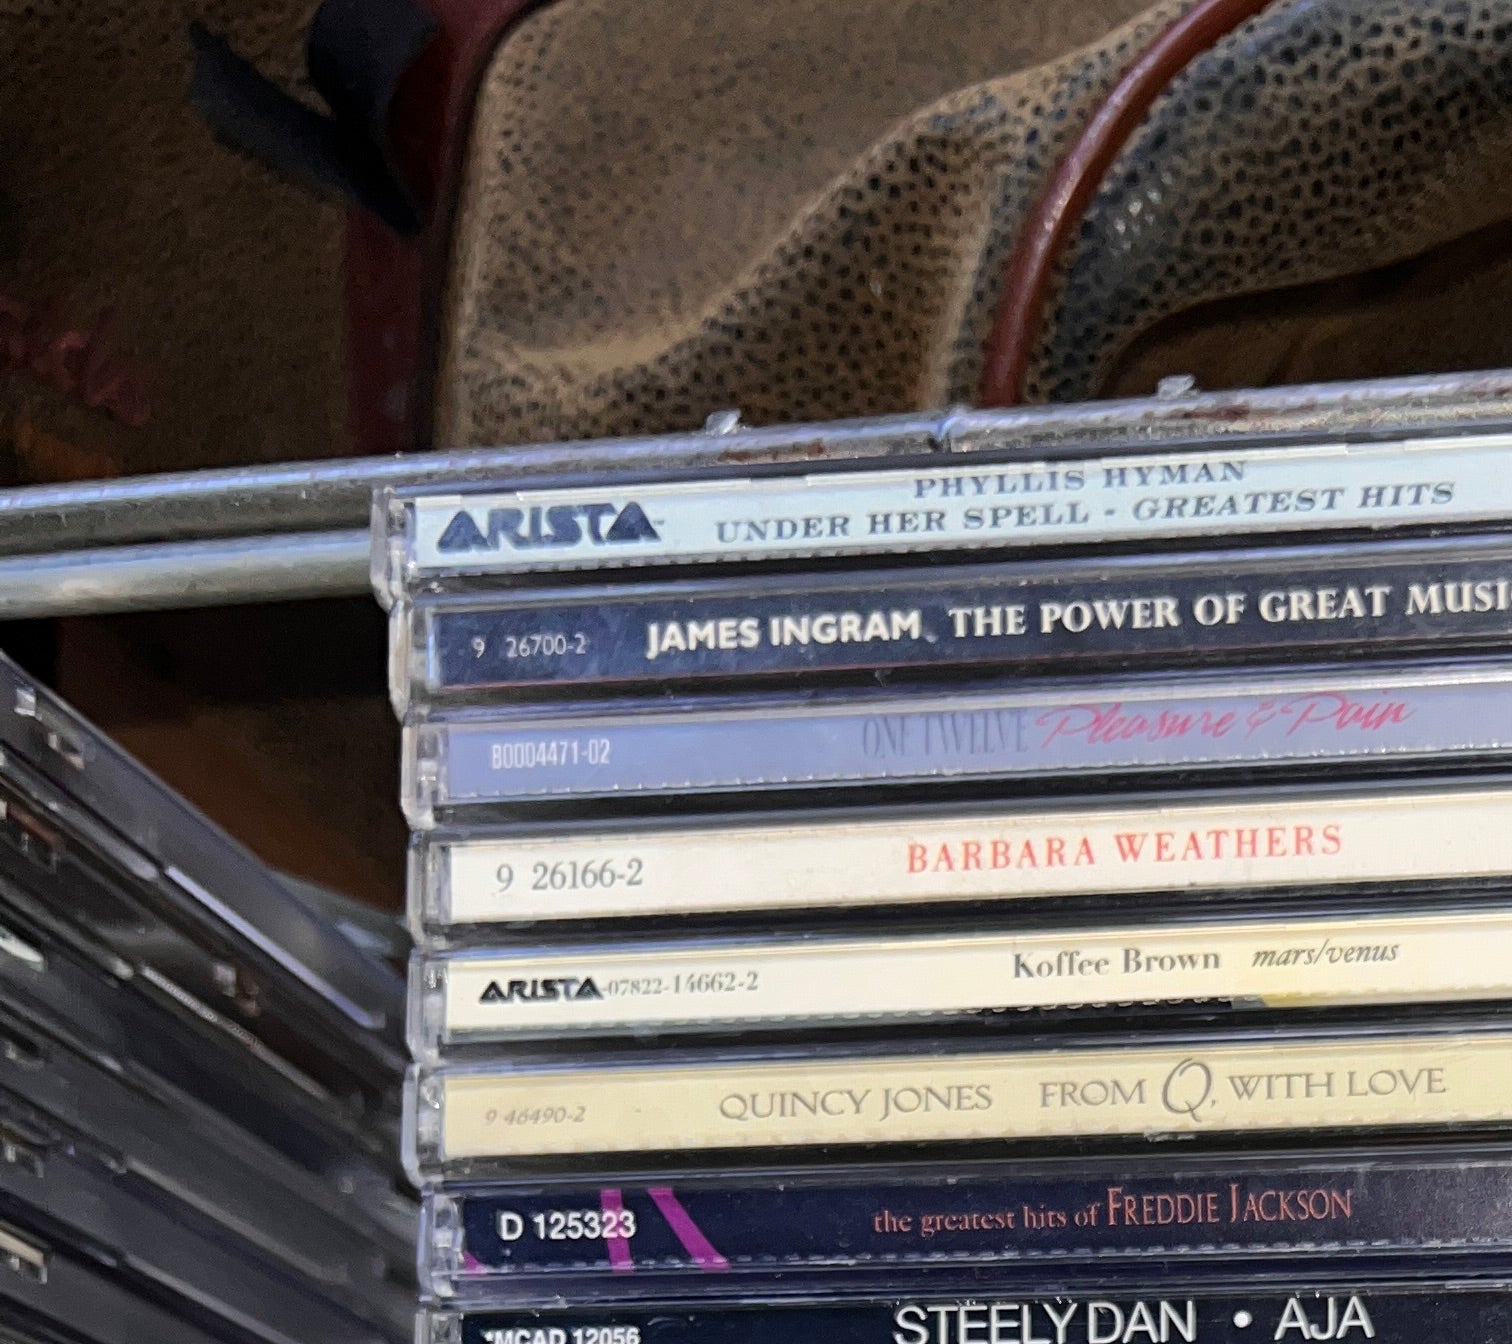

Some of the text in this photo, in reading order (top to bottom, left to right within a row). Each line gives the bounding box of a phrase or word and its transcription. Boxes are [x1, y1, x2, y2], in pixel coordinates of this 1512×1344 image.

[914, 459, 1245, 498] PHYLLIS HYMAN
[438, 501, 661, 553] ARISTA
[716, 482, 1455, 544] UNDER HER SPELL GREATEST HITS
[506, 633, 588, 658] 26700-2
[646, 620, 759, 659] JAMES
[949, 606, 1026, 638] THE
[1041, 599, 1178, 635] POWER
[1199, 596, 1245, 626] OF
[1259, 588, 1390, 621] GREAT
[531, 857, 642, 892] 26166-2
[906, 834, 1096, 874] BARBARA
[1114, 825, 1342, 865] WEATHERS
[1012, 940, 1400, 980] Koffee Brown mars/venus
[502, 1066, 1447, 1127] 46490-2 QUINCY JONES FROM WITH LOVE
[533, 1211, 636, 1240] 125323
[873, 1202, 1098, 1238] the greatest hits of
[1274, 1298, 1375, 1342] AJA
